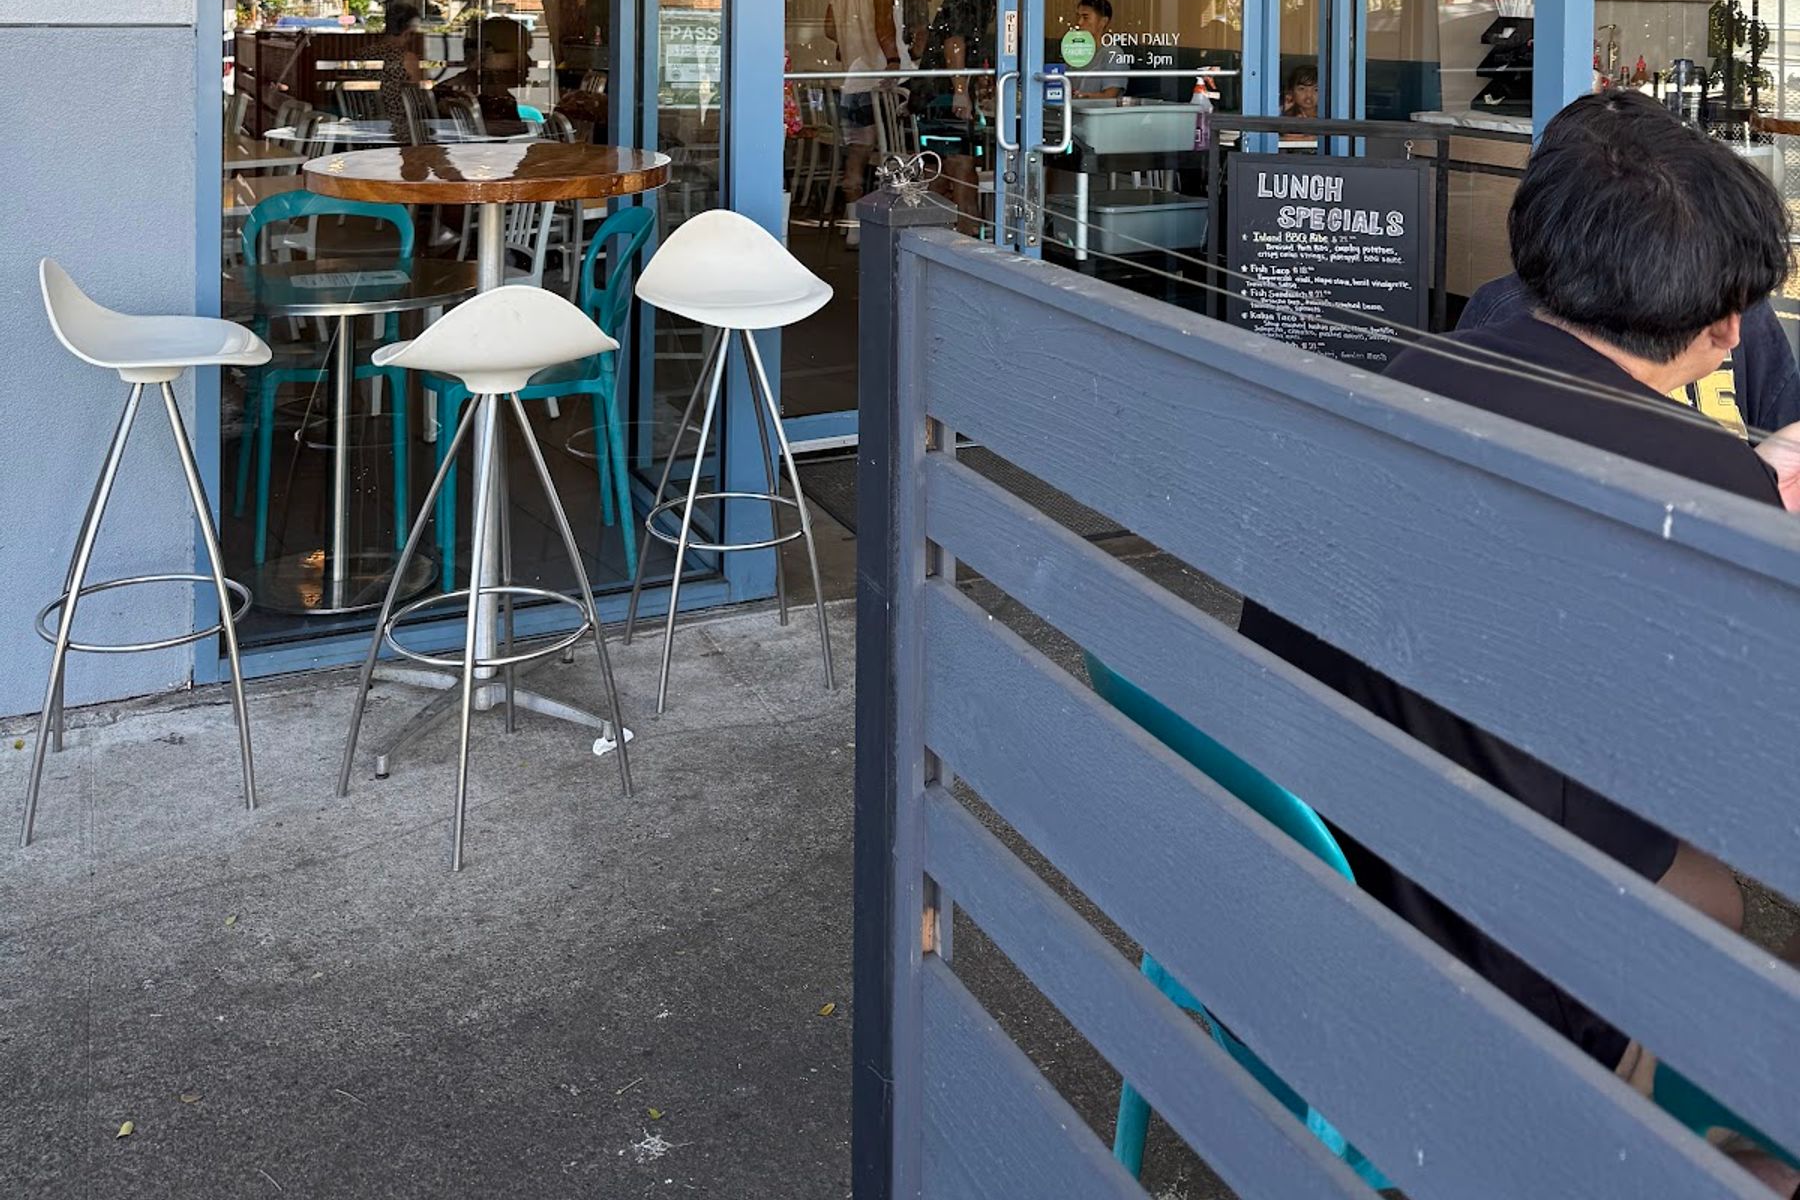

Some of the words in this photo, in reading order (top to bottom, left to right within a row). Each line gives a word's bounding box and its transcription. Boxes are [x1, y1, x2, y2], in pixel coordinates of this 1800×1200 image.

[670, 26, 719, 41] PASS
[1006, 13, 1016, 54] PULL
[1101, 32, 1138, 47] OPEN
[1142, 32, 1180, 46] DAILY
[1108, 50, 1135, 65] 7am
[1146, 51, 1173, 69] 3pm
[1257, 172, 1344, 202] LUNCH
[1277, 205, 1404, 237] SPECIALS
[1285, 231, 1307, 244] BBQ
[1250, 263, 1268, 274] Fish
[1270, 265, 1291, 275] Taco
[1276, 312, 1297, 322] Taco
